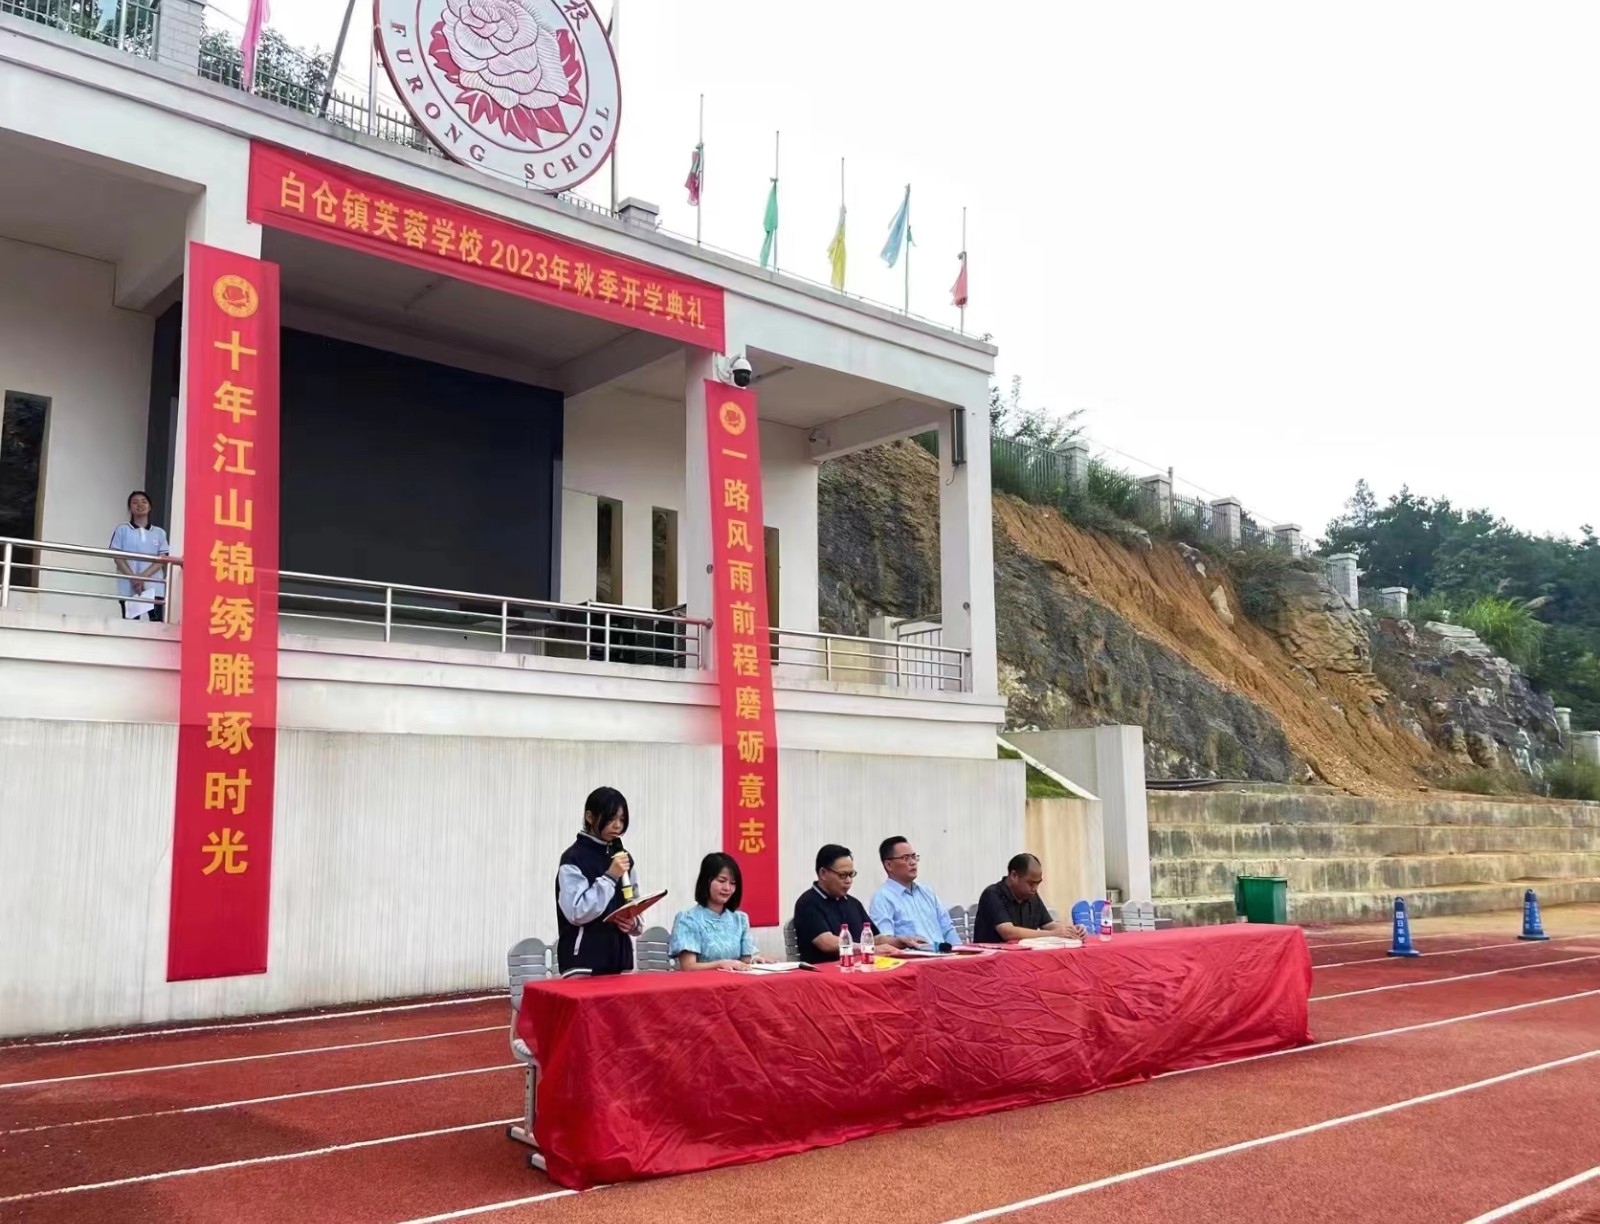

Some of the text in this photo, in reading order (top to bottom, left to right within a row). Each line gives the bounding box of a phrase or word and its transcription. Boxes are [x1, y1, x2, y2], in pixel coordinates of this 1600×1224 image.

[391, 22, 609, 180] FURONG SCHOOL
[202, 330, 257, 876] 十年江山锦绣雕琢时光
[721, 448, 766, 854] 一路风雨前程磨砺意志
